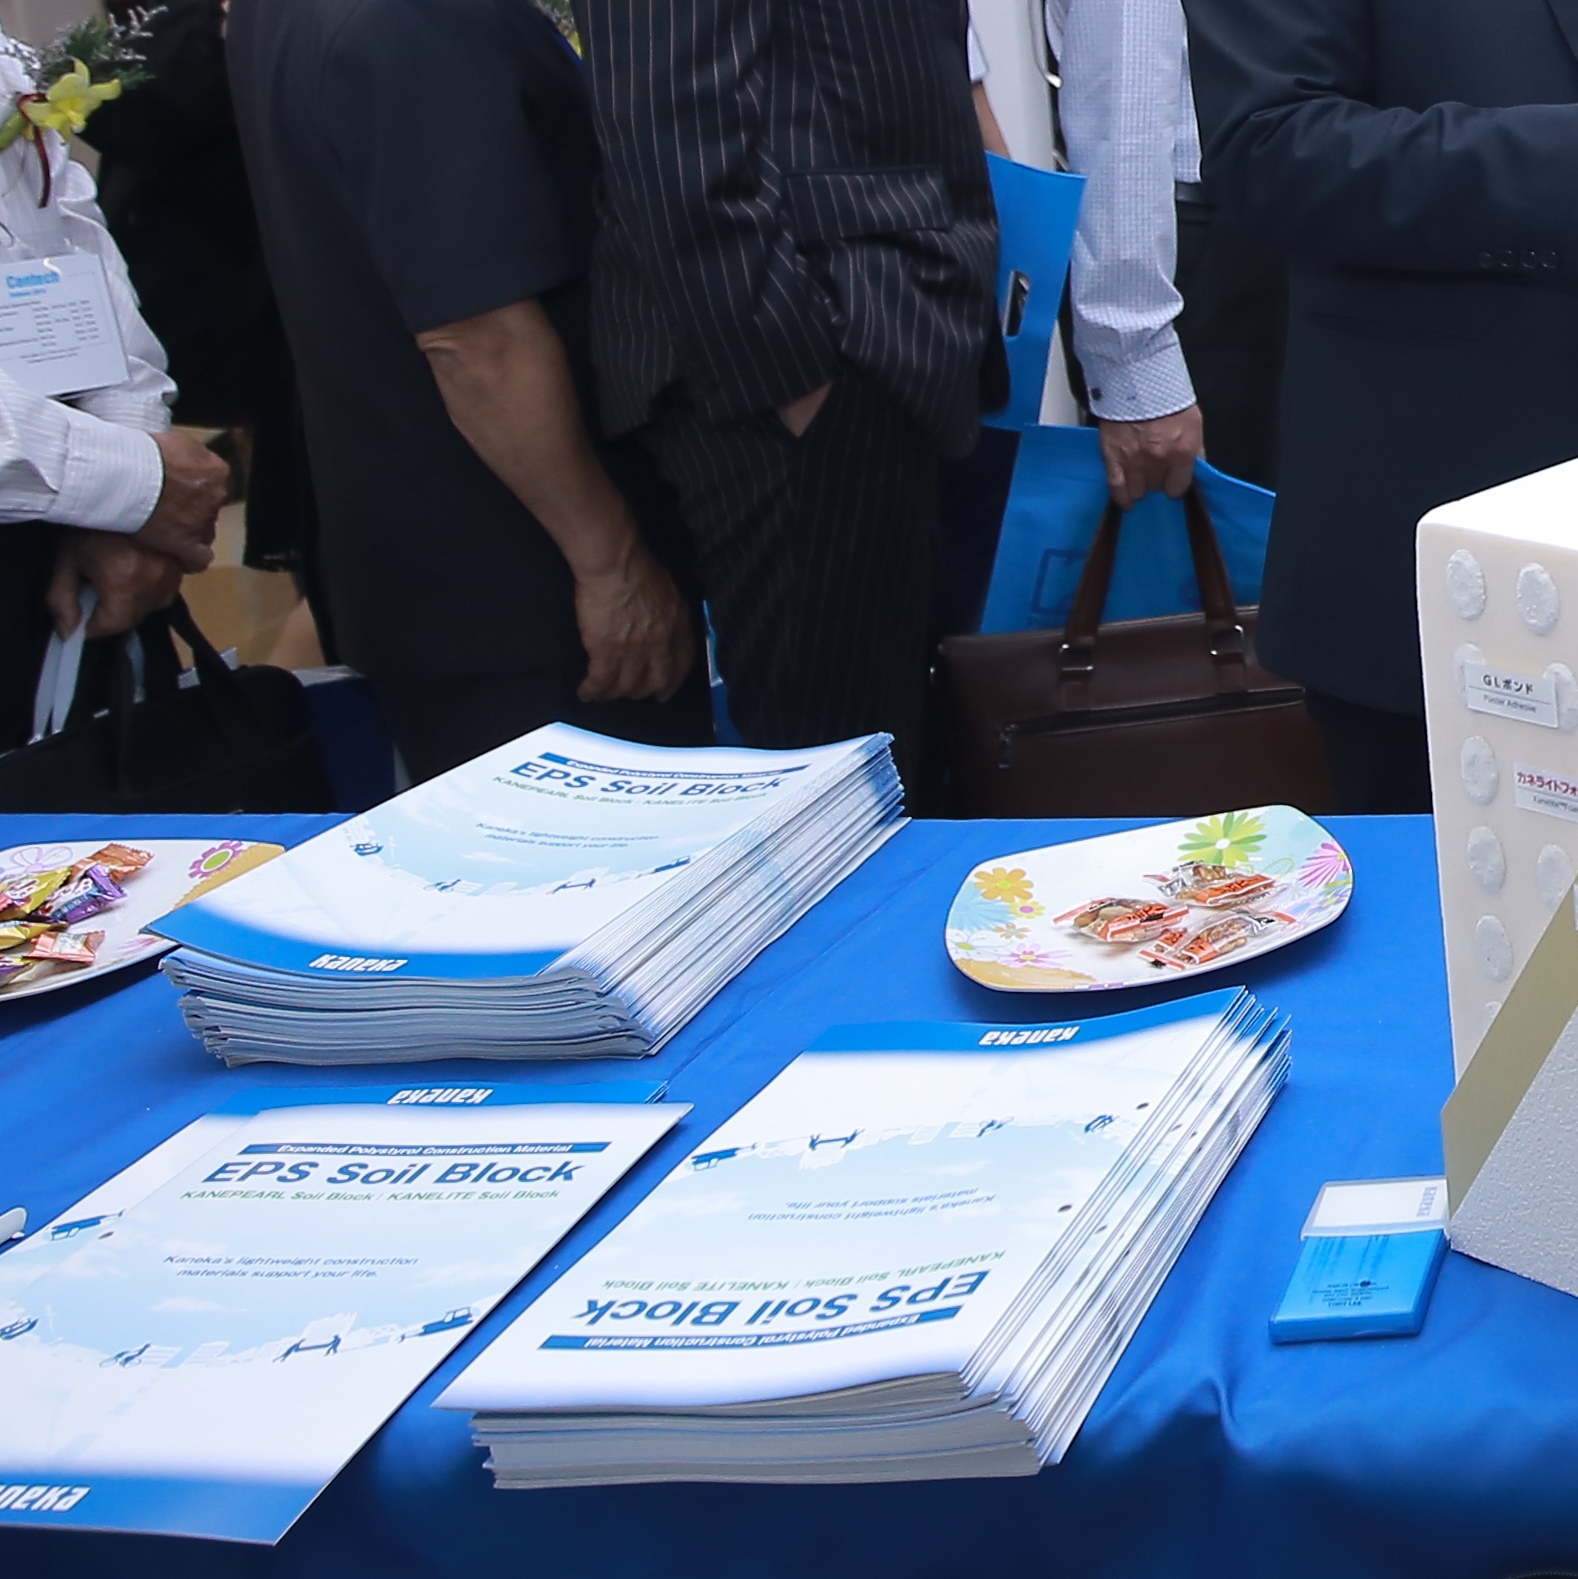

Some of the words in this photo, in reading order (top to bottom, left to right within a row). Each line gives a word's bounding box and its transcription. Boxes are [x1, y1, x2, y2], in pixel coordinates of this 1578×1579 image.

[510, 761, 596, 789] EPS
[600, 779, 680, 796] Soil
[679, 777, 789, 797] Block
[276, 1144, 350, 1154] Expanded
[348, 1145, 423, 1156] Polystyrol
[422, 1145, 512, 1155] Construction
[512, 1144, 574, 1154] Material
[201, 1160, 320, 1184] EPS
[326, 1162, 433, 1185] Soil
[433, 1160, 588, 1185] Block
[179, 1189, 286, 1201] KANEPEARL
[290, 1190, 326, 1201] Soil
[325, 1191, 373, 1201] Block
[386, 1191, 475, 1201] KANELITE
[477, 1190, 512, 1200] Soil
[511, 1190, 562, 1200] Block
[911, 1187, 979, 1202] materials
[785, 1201, 812, 1210] life.
[813, 1200, 849, 1209] your
[850, 1196, 910, 1208] support
[927, 1194, 996, 1213] Kaneka's
[747, 1212, 843, 1222] construction
[843, 1206, 928, 1220] lightweight
[162, 1254, 235, 1265] Kaneka's
[236, 1255, 321, 1266] lightweight
[322, 1256, 420, 1266] construction
[897, 1249, 1007, 1277] KANEPEARL
[176, 1268, 250, 1278] materials
[251, 1269, 312, 1279] support
[312, 1270, 348, 1279] your
[349, 1269, 379, 1278] life.
[857, 1270, 892, 1284] Soil
[601, 1279, 655, 1291] Block
[654, 1280, 691, 1292] Soil
[692, 1280, 791, 1292] KANELITE
[802, 1275, 855, 1289] Block
[868, 1268, 992, 1312] EPS
[571, 1298, 742, 1327] Block
[743, 1293, 858, 1327] Soil
[841, 1314, 921, 1336] Expanded
[583, 1336, 654, 1348] Material
[653, 1335, 757, 1347] Construction
[757, 1326, 843, 1346] Polystyrol
[0, 1485, 91, 1511] neka
